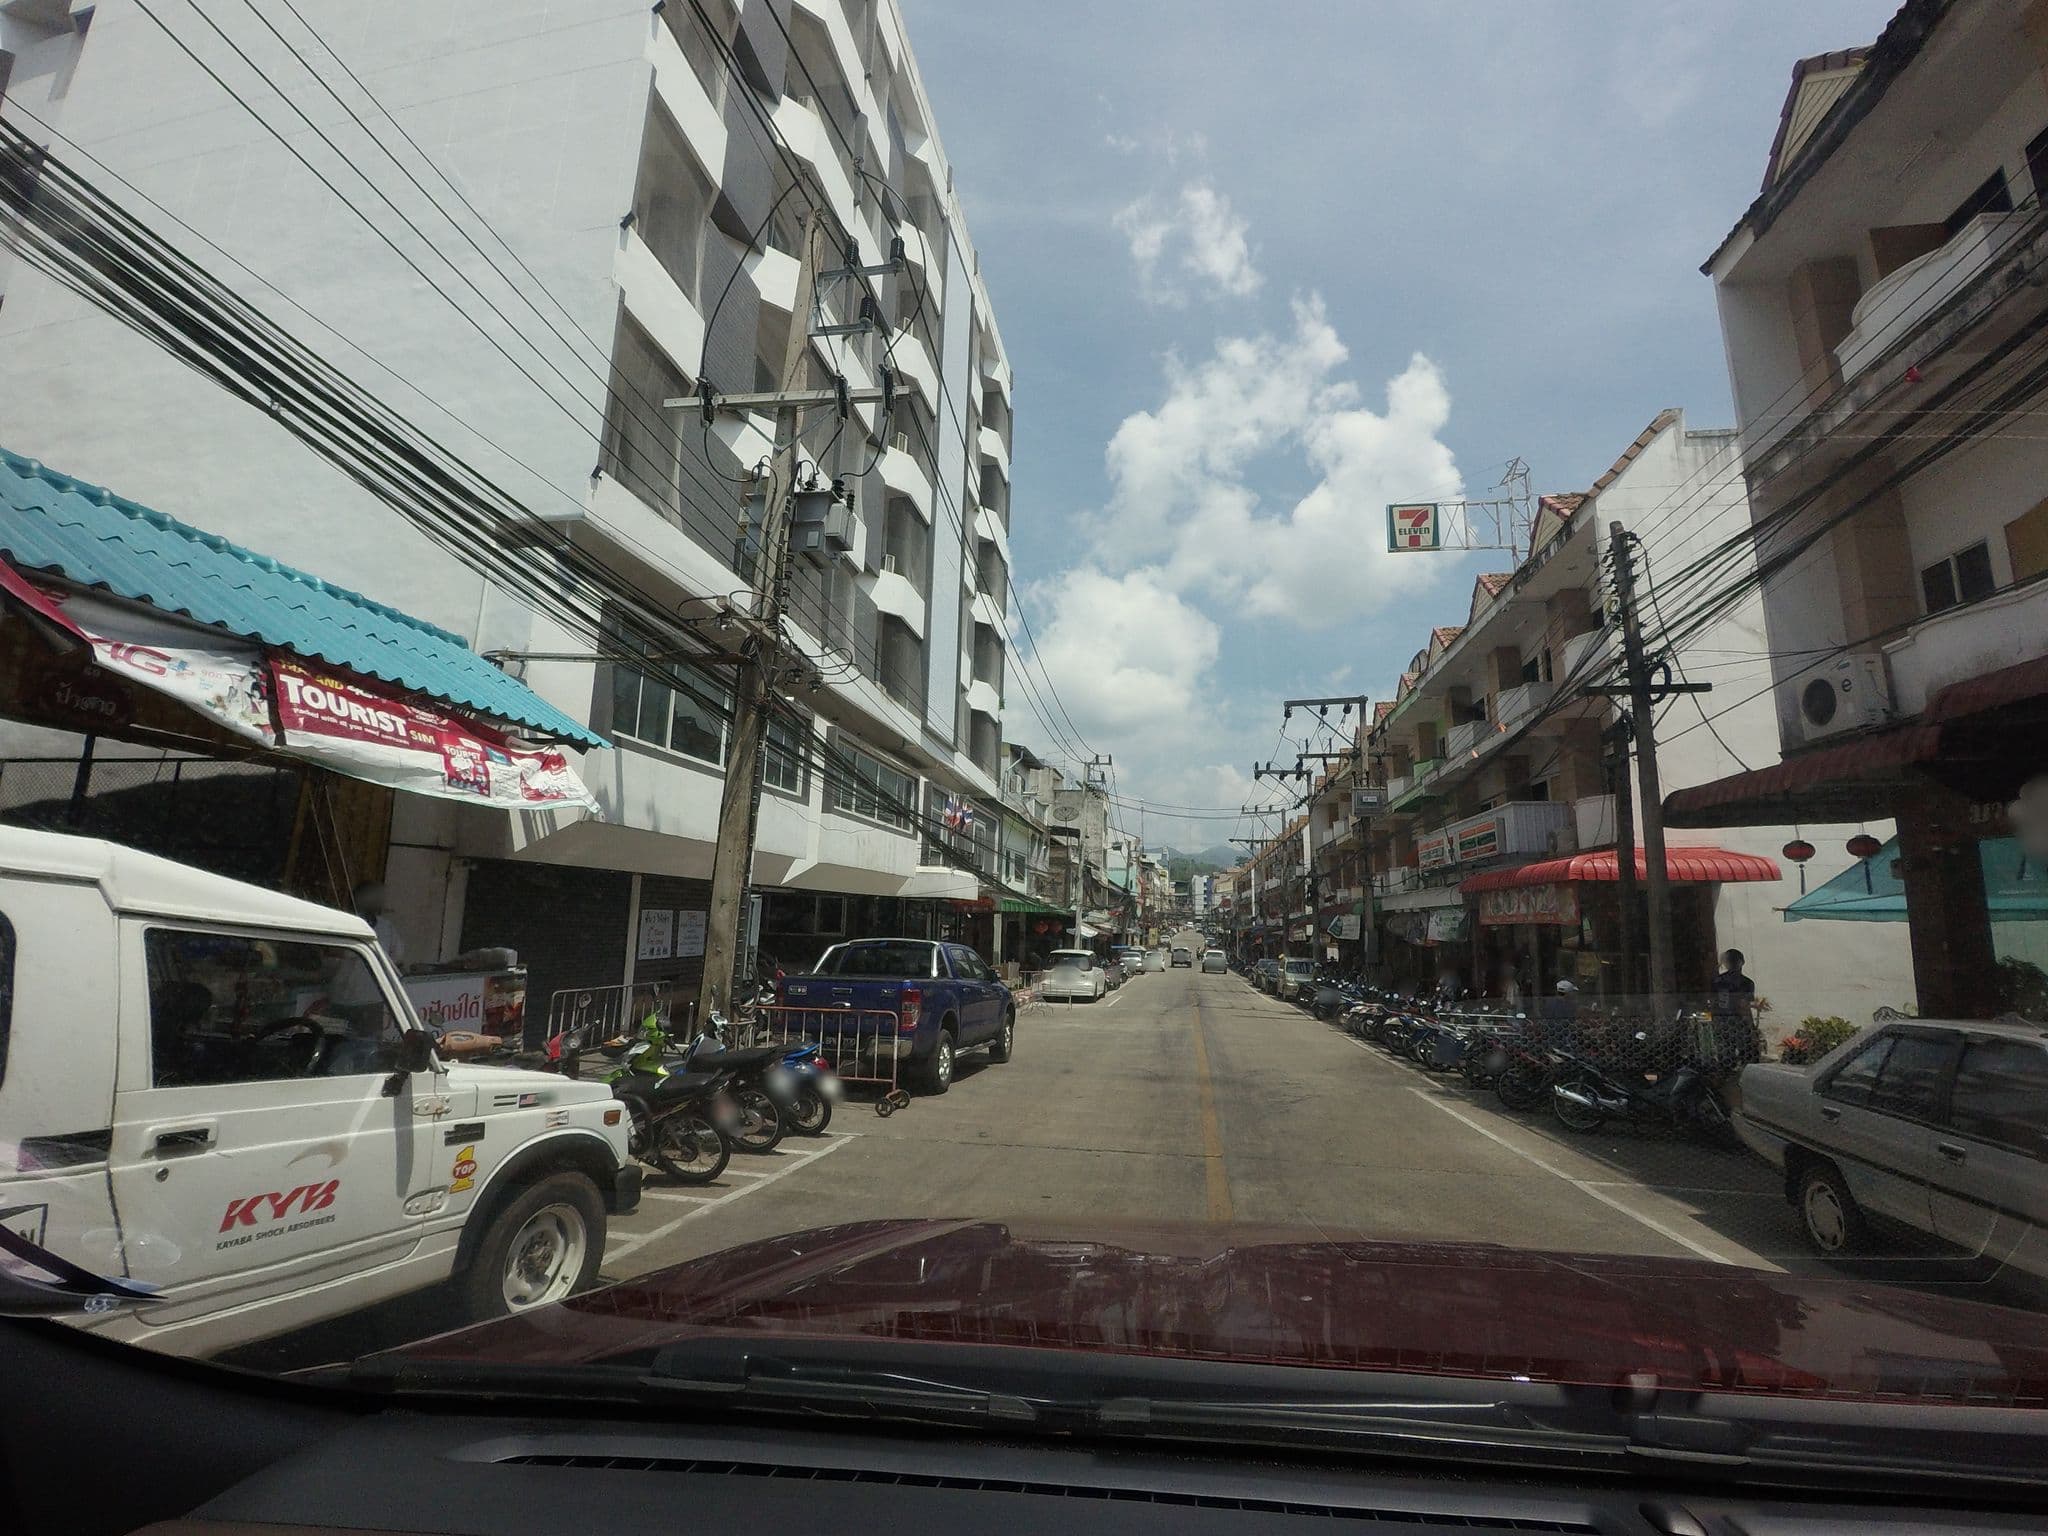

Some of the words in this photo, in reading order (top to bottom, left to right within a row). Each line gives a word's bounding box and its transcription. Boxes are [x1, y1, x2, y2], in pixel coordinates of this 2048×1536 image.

[1399, 509, 1428, 547] 7
[279, 673, 407, 737] TOURIST
[409, 729, 436, 746] SIM
[454, 1163, 475, 1177] TOP
[218, 1178, 340, 1233] KYB
[215, 1233, 253, 1251] KAYABA
[255, 1226, 285, 1241] SHOCK
[287, 1214, 337, 1233] ABSORBERS
